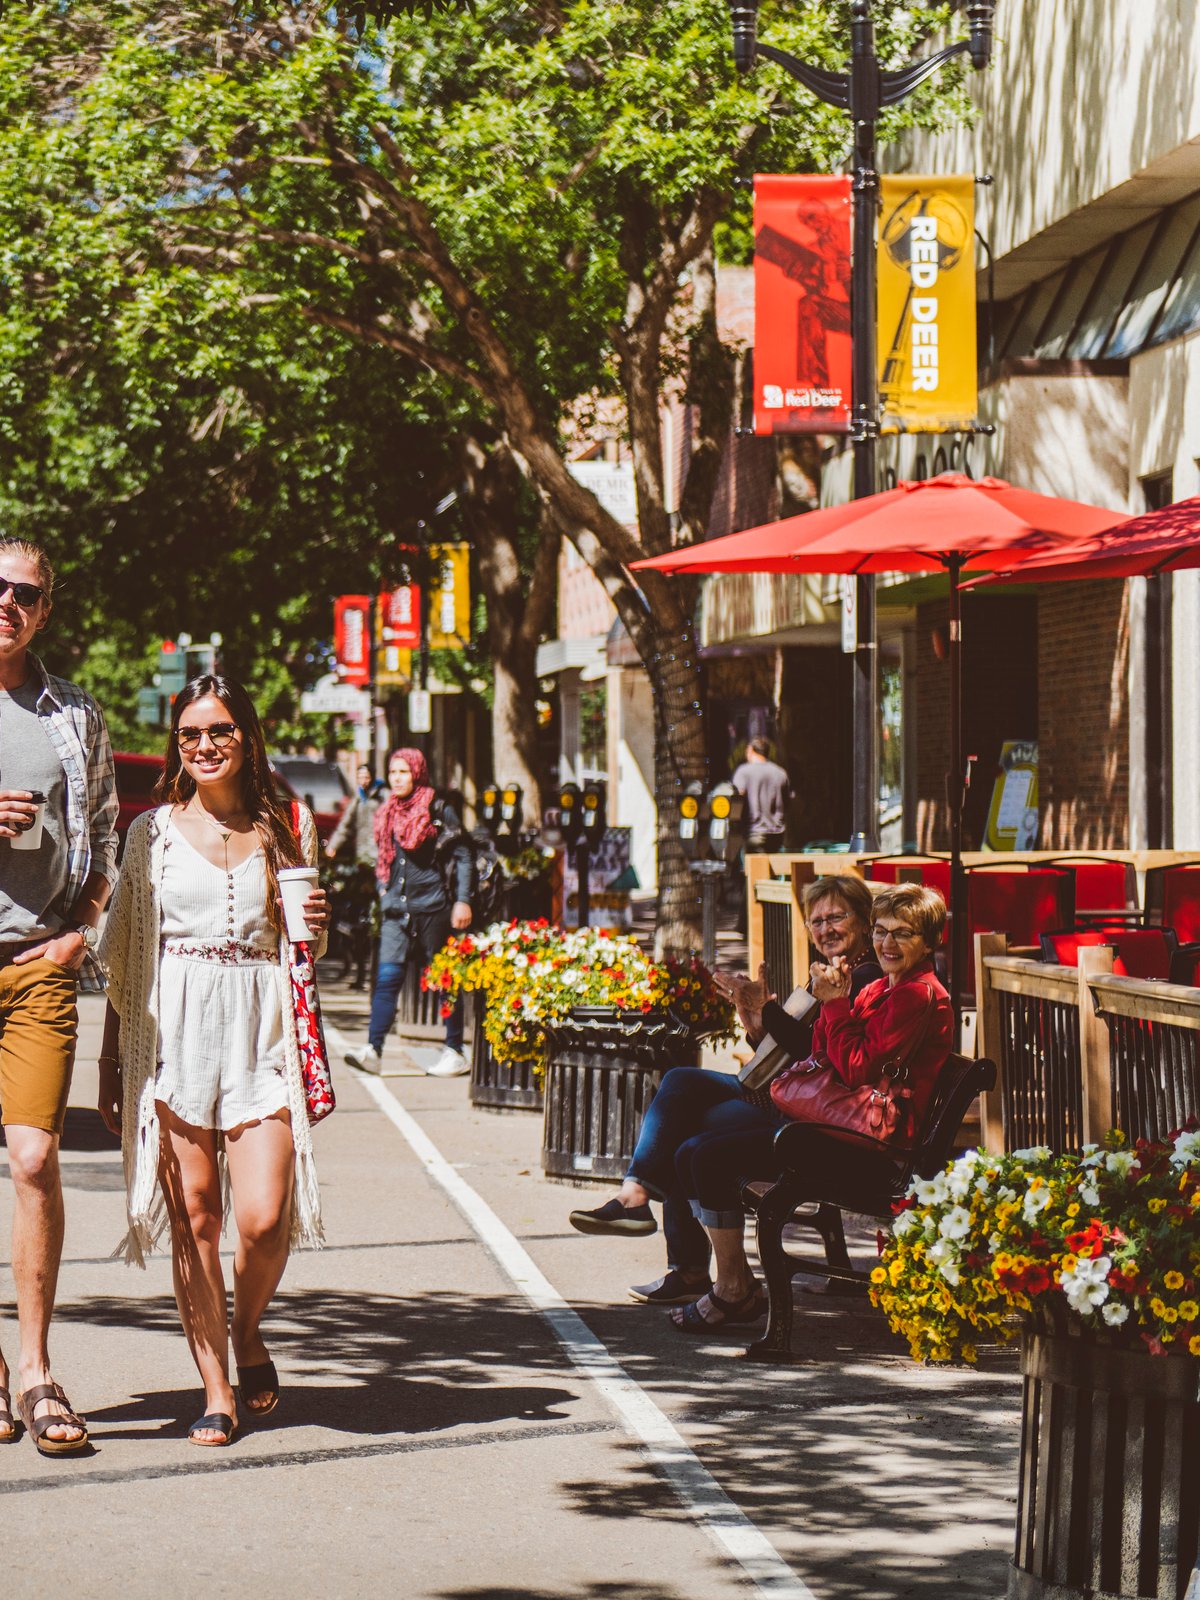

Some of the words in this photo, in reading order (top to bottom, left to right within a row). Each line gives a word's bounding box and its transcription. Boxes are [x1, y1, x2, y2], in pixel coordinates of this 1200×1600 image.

[911, 216, 939, 289] RED
[911, 297, 940, 393] DEER
[785, 391, 810, 407] Red
[811, 391, 842, 407] Deer
